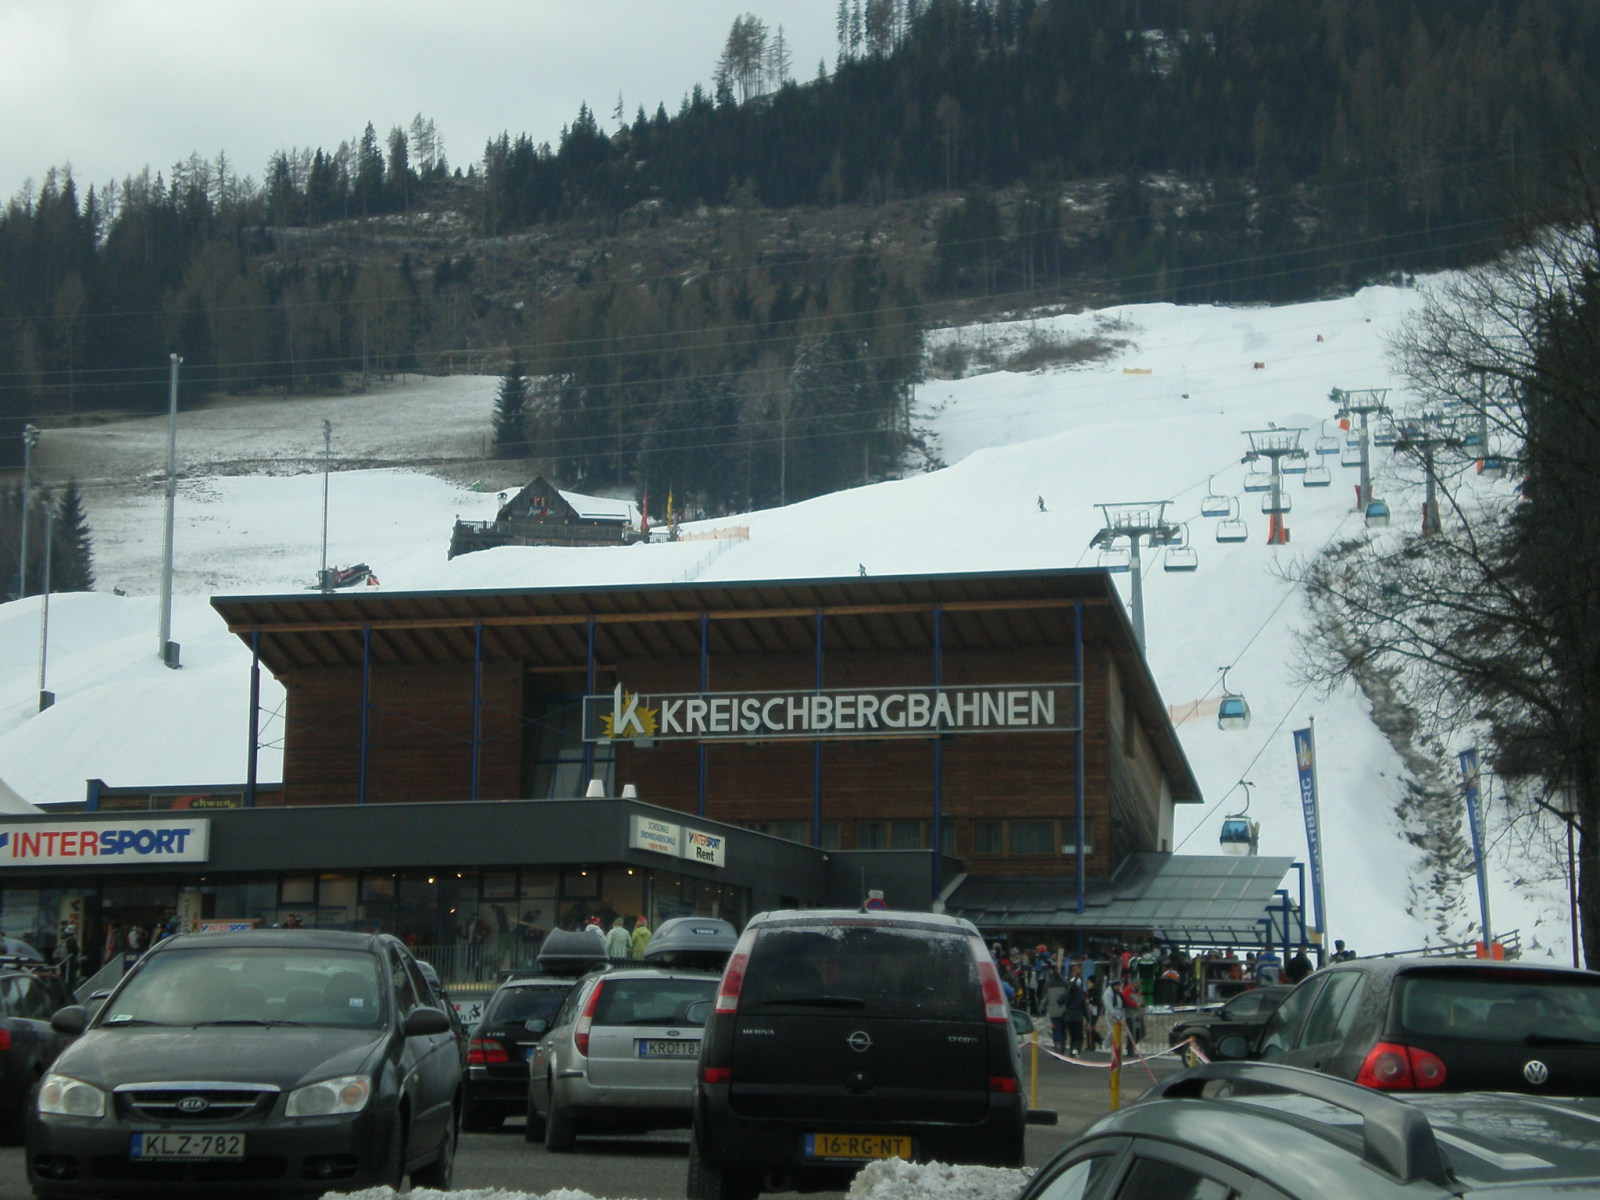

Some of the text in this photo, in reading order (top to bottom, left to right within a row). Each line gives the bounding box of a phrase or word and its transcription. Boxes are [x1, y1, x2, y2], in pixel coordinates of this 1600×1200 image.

[660, 689, 1055, 735] KREISCHBERGBAHNEN
[12, 828, 191, 858] INTERSPORT
[696, 846, 715, 862] Rent
[742, 1028, 775, 1036] MERIVA
[145, 1135, 240, 1155] KLZ-782
[823, 1136, 903, 1155] 16-RG-NT
